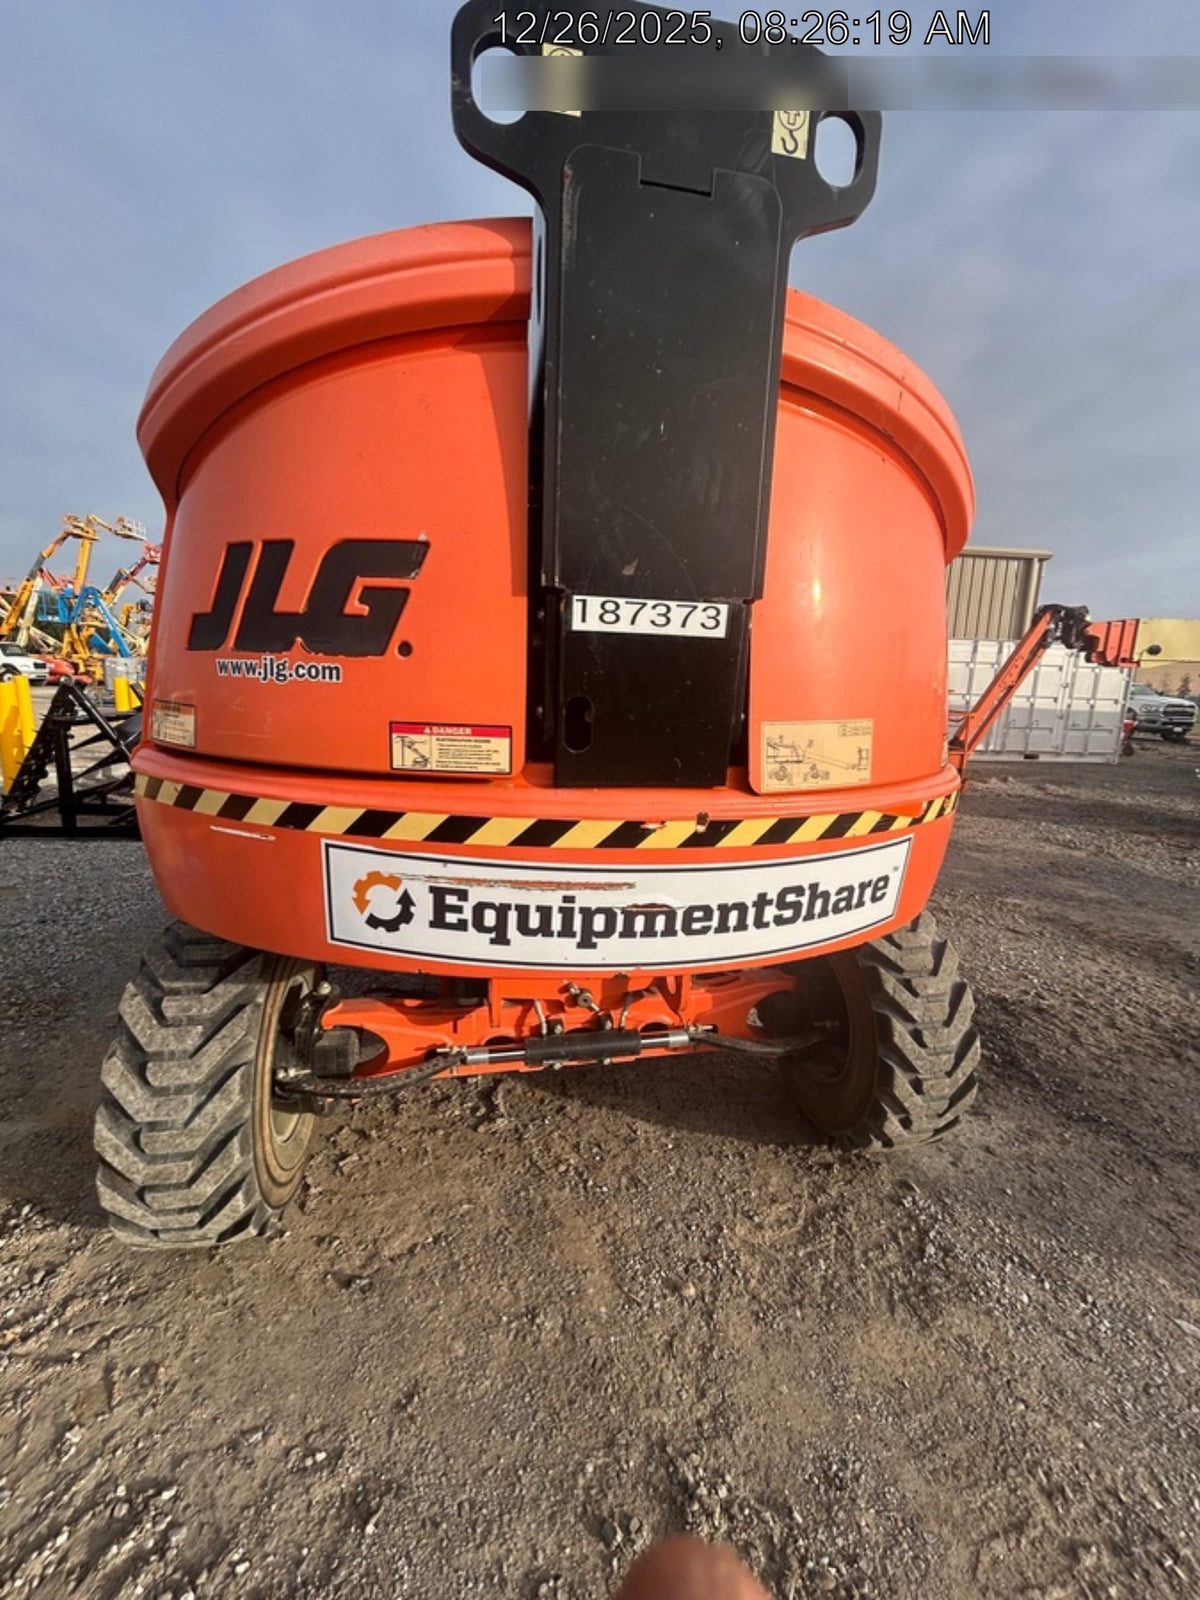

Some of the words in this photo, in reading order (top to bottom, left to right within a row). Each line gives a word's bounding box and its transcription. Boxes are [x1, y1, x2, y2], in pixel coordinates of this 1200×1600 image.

[575, 598, 722, 630] 187373
[216, 656, 341, 683] www.jlg.com
[432, 726, 472, 735] DANGER
[428, 874, 890, 949] EquipmentShare
